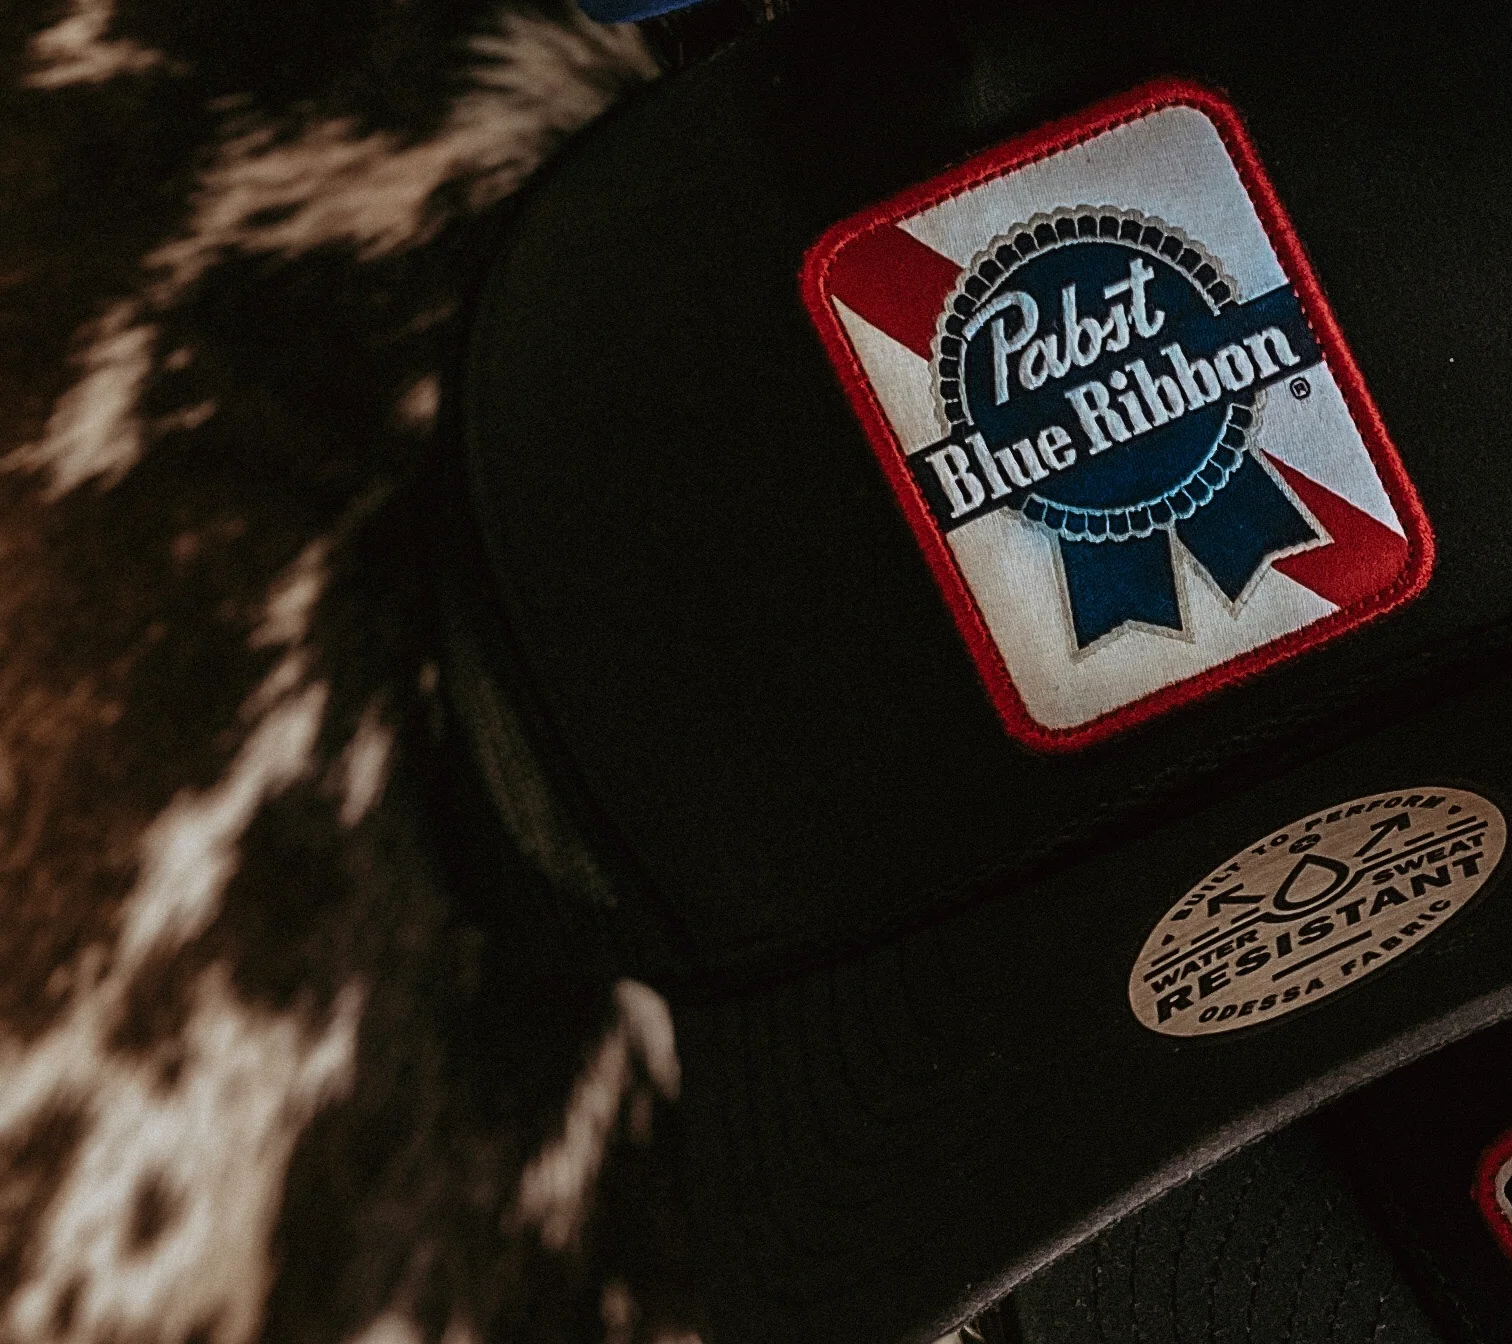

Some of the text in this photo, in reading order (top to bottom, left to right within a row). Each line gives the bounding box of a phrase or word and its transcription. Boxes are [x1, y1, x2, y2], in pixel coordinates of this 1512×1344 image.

[962, 258, 1165, 406] Pabst
[925, 325, 1301, 519] Blue Ribbon
[1151, 832, 1486, 993] WATER SWEAT
[1171, 795, 1448, 921] BUILT TO PERFORM
[1157, 852, 1483, 1025] RESISTANT
[1198, 899, 1451, 1023] ODESSA FABRIC
